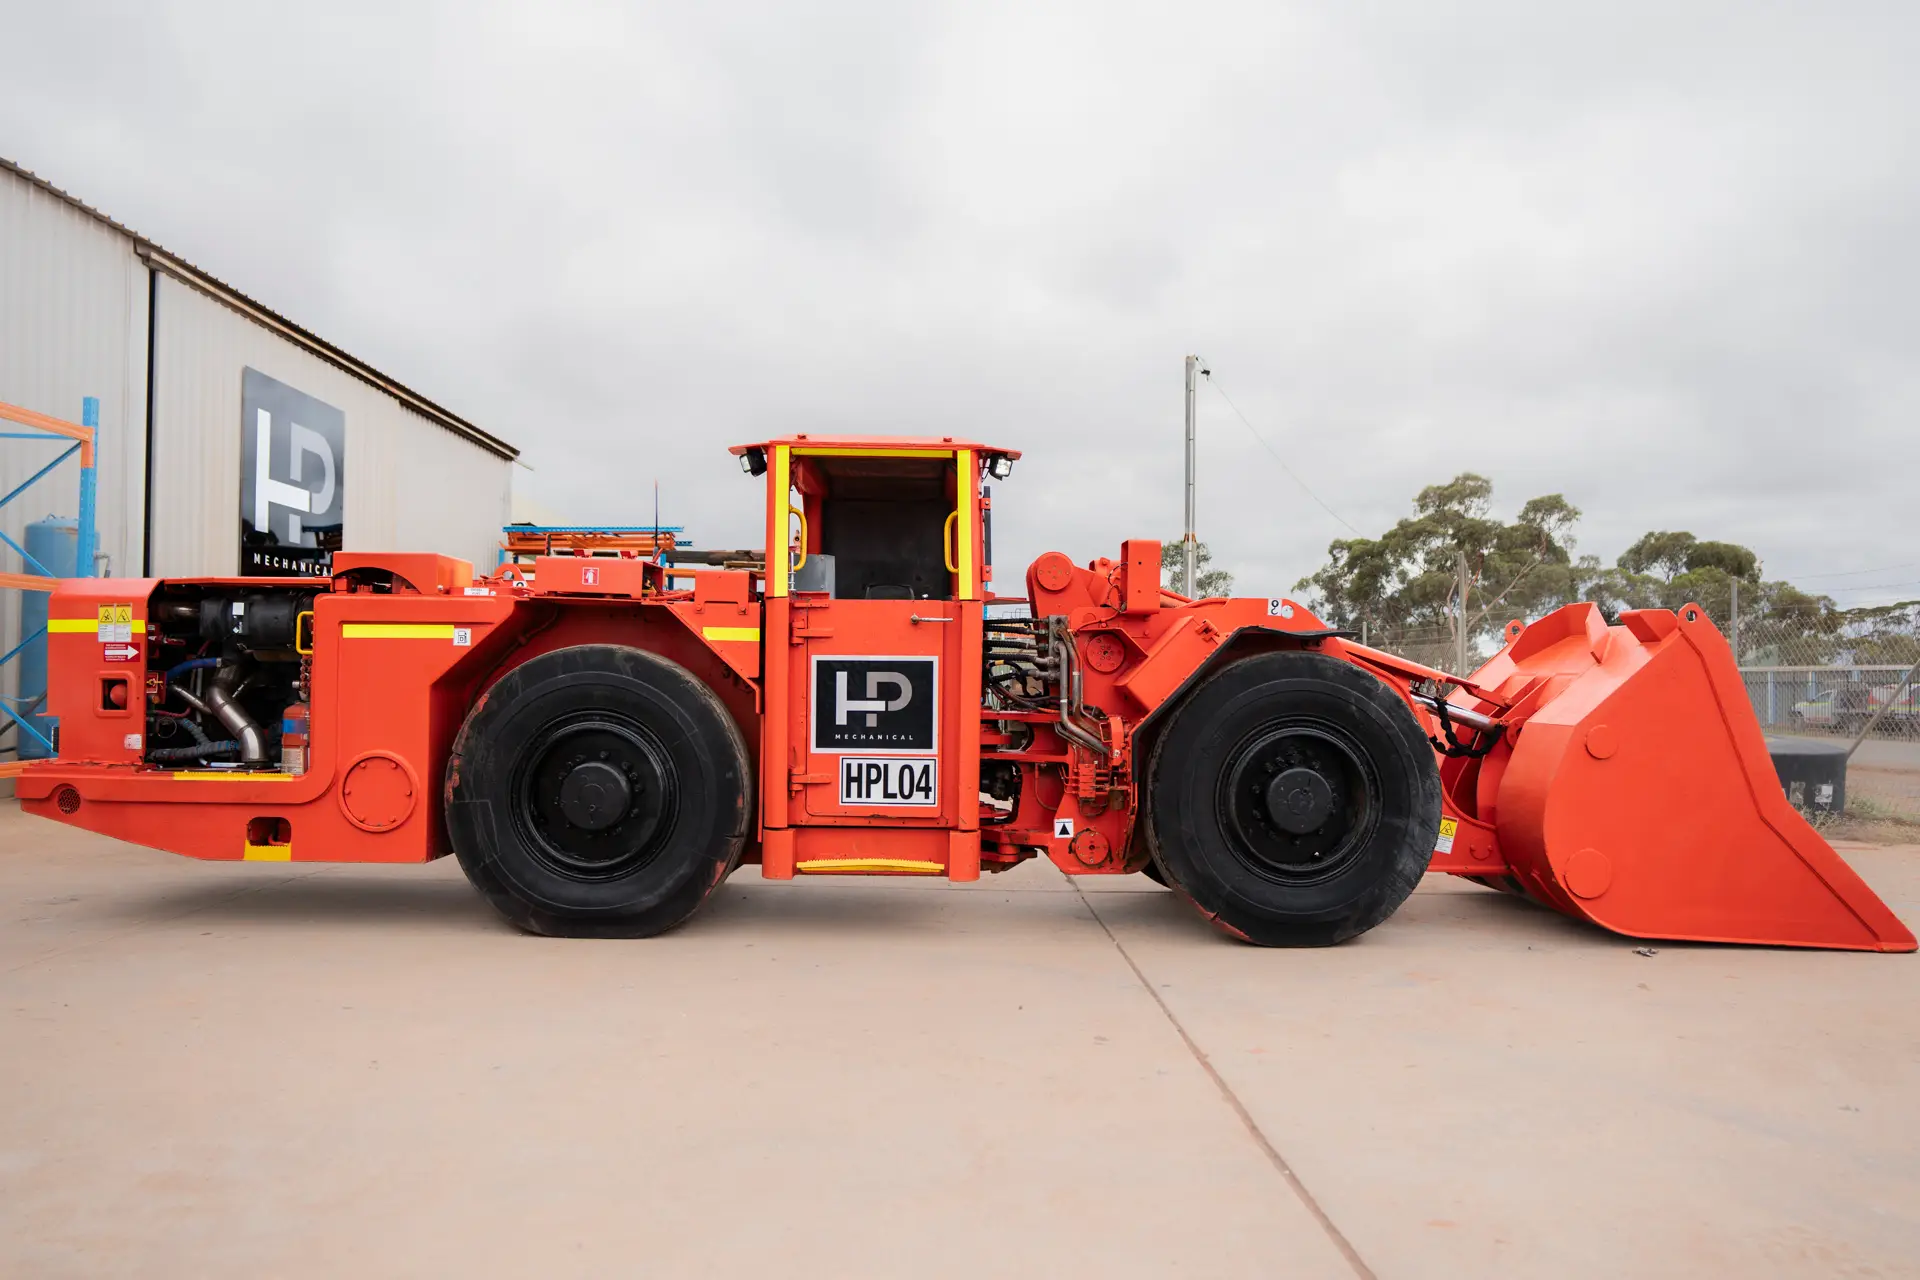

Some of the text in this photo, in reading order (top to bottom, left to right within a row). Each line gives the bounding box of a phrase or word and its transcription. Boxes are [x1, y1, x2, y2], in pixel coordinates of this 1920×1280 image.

[255, 408, 336, 545] HP
[835, 671, 913, 728] HP
[835, 733, 914, 741] MECHANICAL
[845, 762, 932, 800] HPL04
